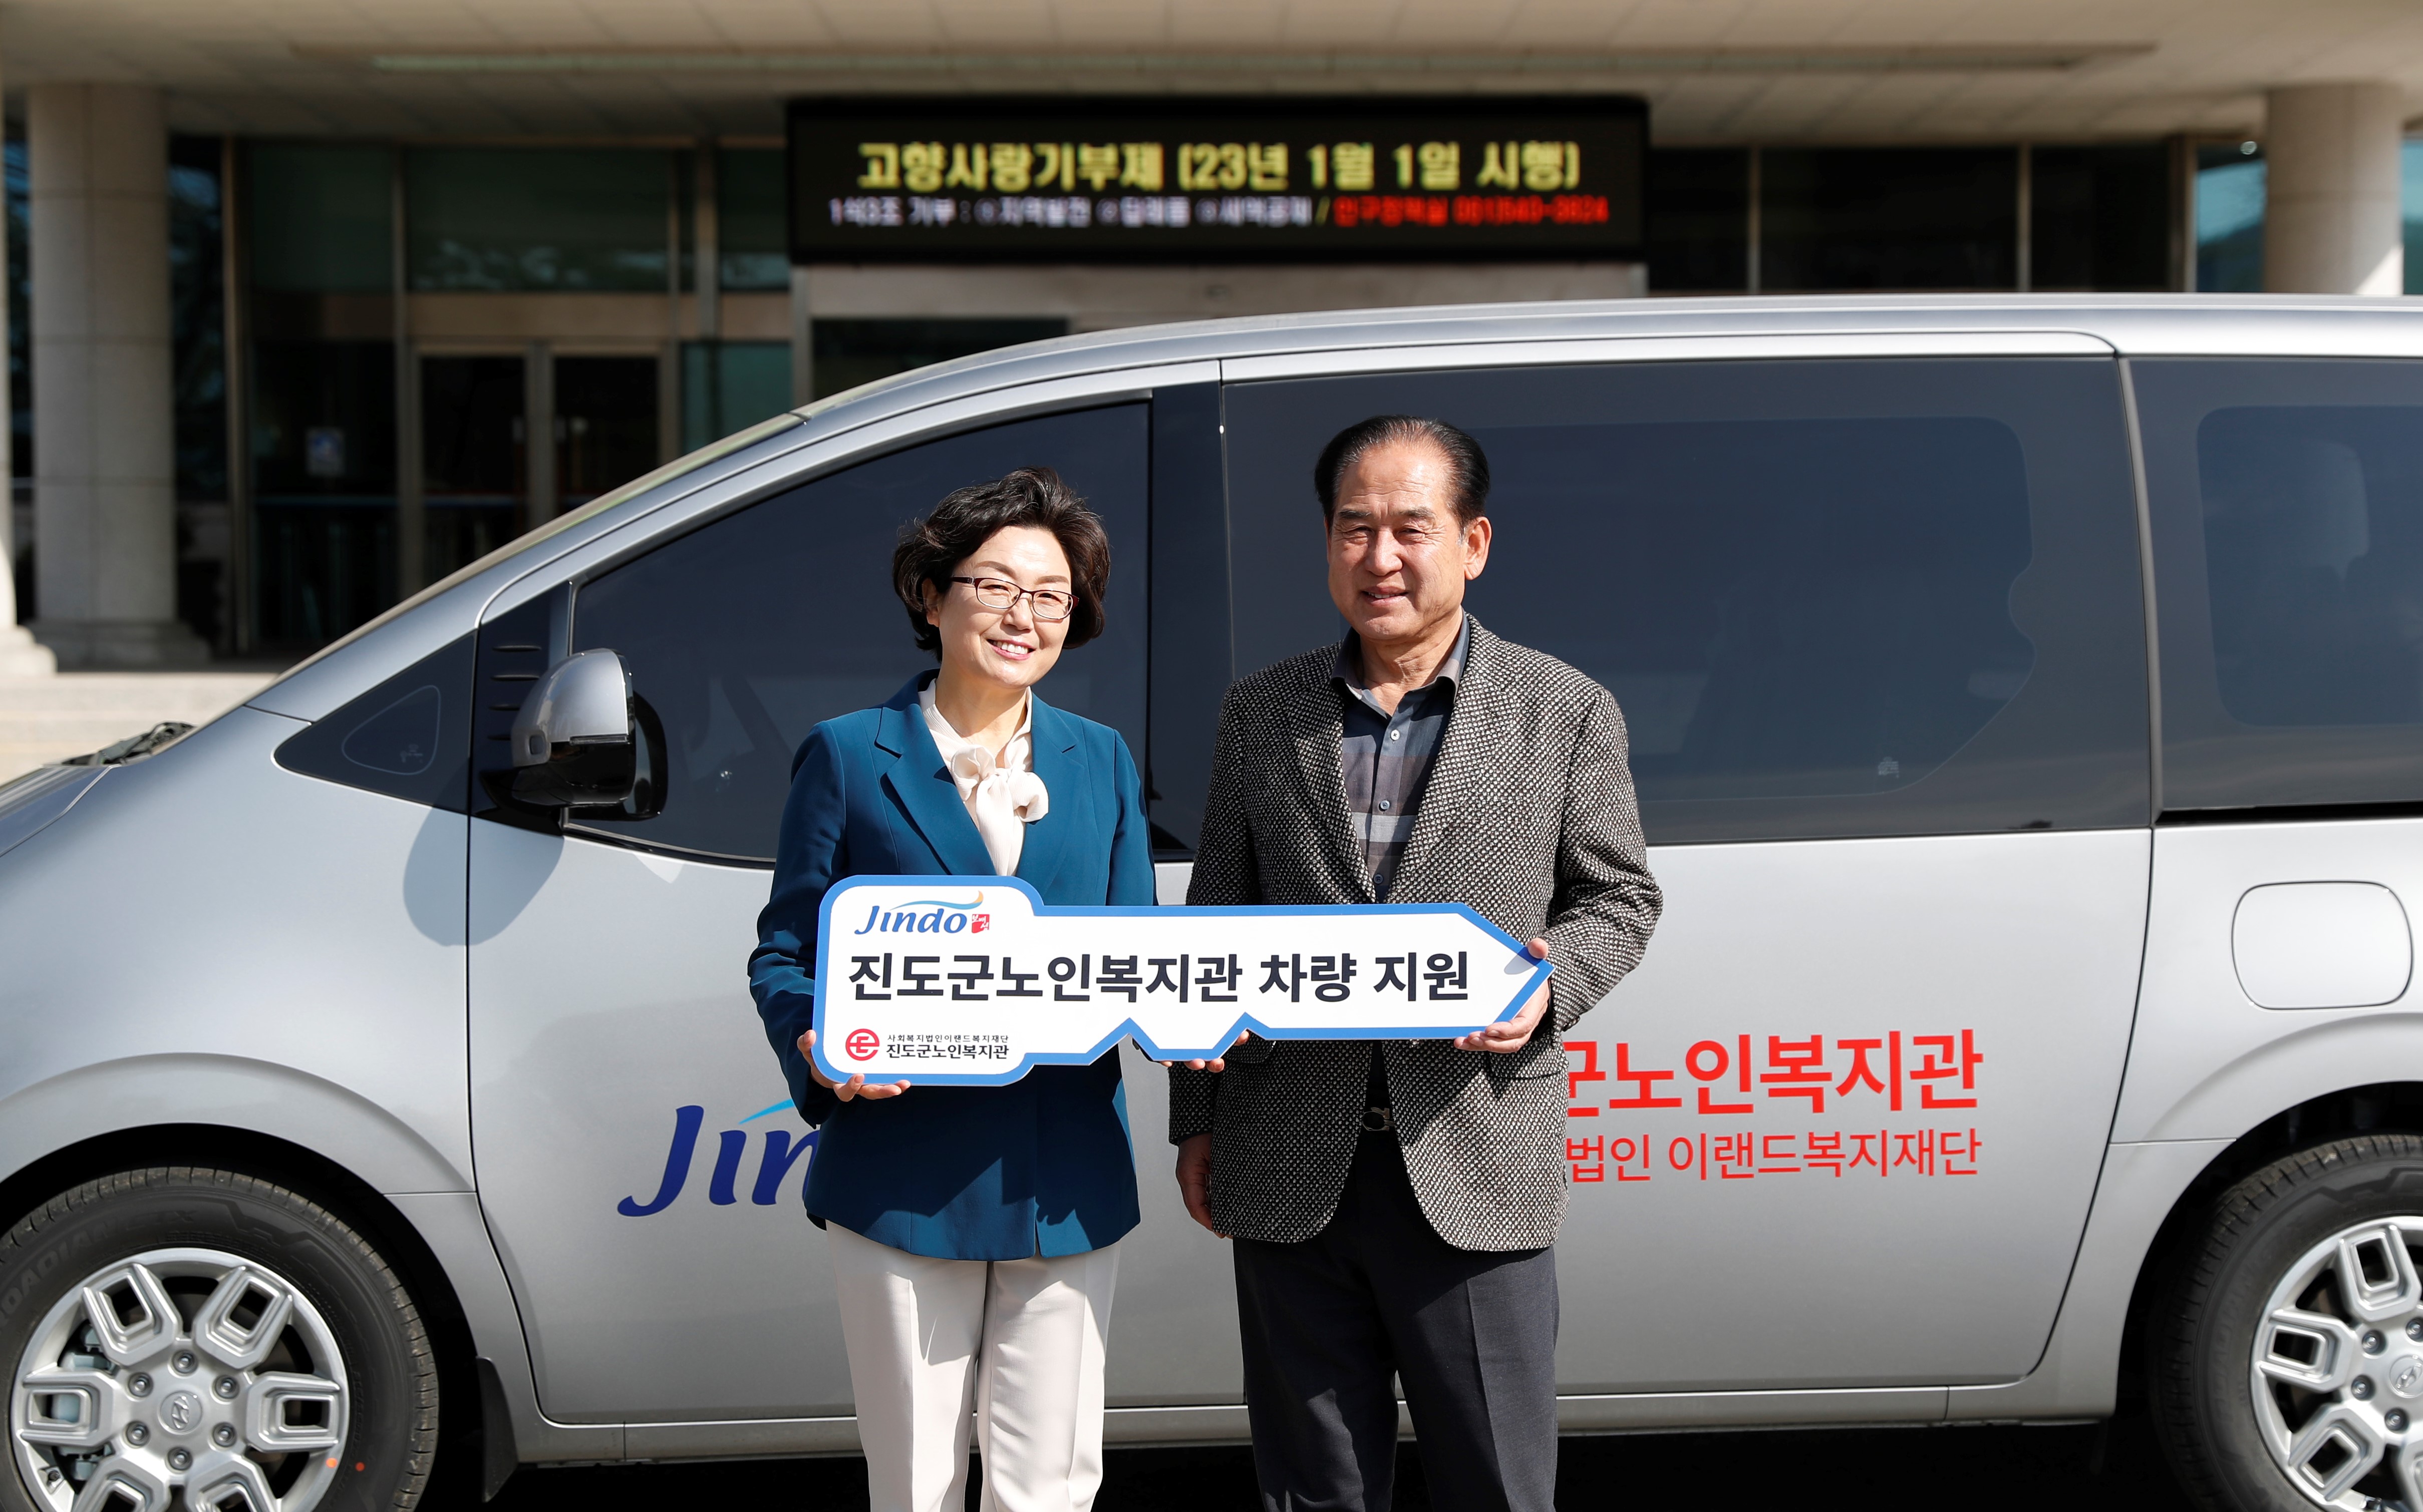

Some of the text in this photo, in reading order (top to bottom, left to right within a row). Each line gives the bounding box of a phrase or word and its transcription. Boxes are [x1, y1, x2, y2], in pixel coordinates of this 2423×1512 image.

[857, 142, 1163, 192] 고향사랑기부제
[1307, 143, 1375, 190] 1월
[1392, 142, 1460, 190] 1일
[906, 196, 957, 228] 기부
[854, 905, 968, 935] Jindo
[849, 951, 1468, 1003] 진도군노인복지관 차량 지원
[886, 1043, 1010, 1059] 진도군노인복지관
[887, 1034, 1009, 1043] 사회복지법인이랜드복지재단
[1668, 1127, 1983, 1182] 이랜드복지재단
